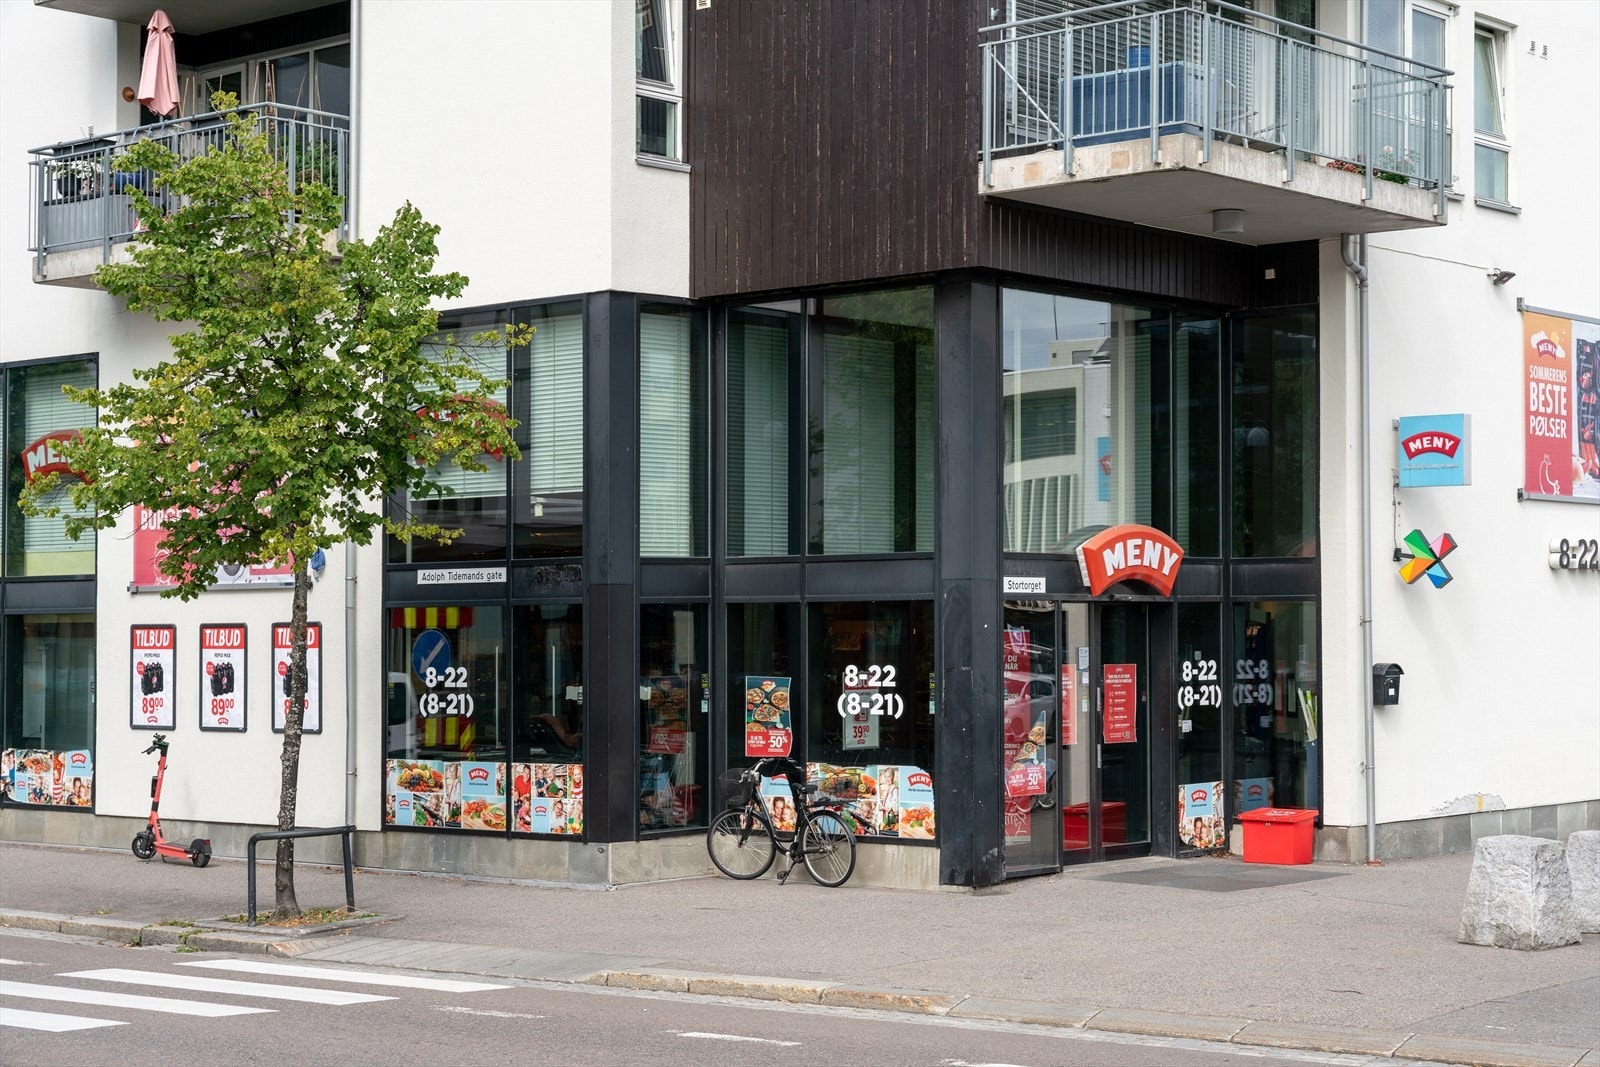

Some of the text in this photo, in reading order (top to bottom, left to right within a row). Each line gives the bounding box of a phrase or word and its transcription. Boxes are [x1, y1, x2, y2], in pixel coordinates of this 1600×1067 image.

[1539, 342, 1556, 355] MENY
[1529, 365, 1567, 383] SOMMERENS
[1529, 381, 1567, 416] BESTE
[1529, 415, 1567, 439] PØLSER
[1408, 436, 1455, 453] MENY
[27, 440, 80, 474] MEN
[1102, 538, 1179, 577] MENY
[1559, 538, 1599, 570] 8-22
[421, 570, 503, 583] Adolph Tidemands gate
[1007, 580, 1042, 592] Stortorget
[135, 630, 170, 647] TILBUD
[205, 629, 241, 647] TILBUD
[278, 628, 315, 646] TILD
[425, 666, 468, 688] 8-22
[845, 664, 896, 687] 8-22
[1182, 660, 1217, 682] 8-22
[419, 693, 474, 718] (8-21)
[837, 692, 904, 720] (8-21)
[1177, 685, 1222, 710] (8-21)
[768, 735, 788, 748] -50%
[910, 775, 931, 784] MENY
